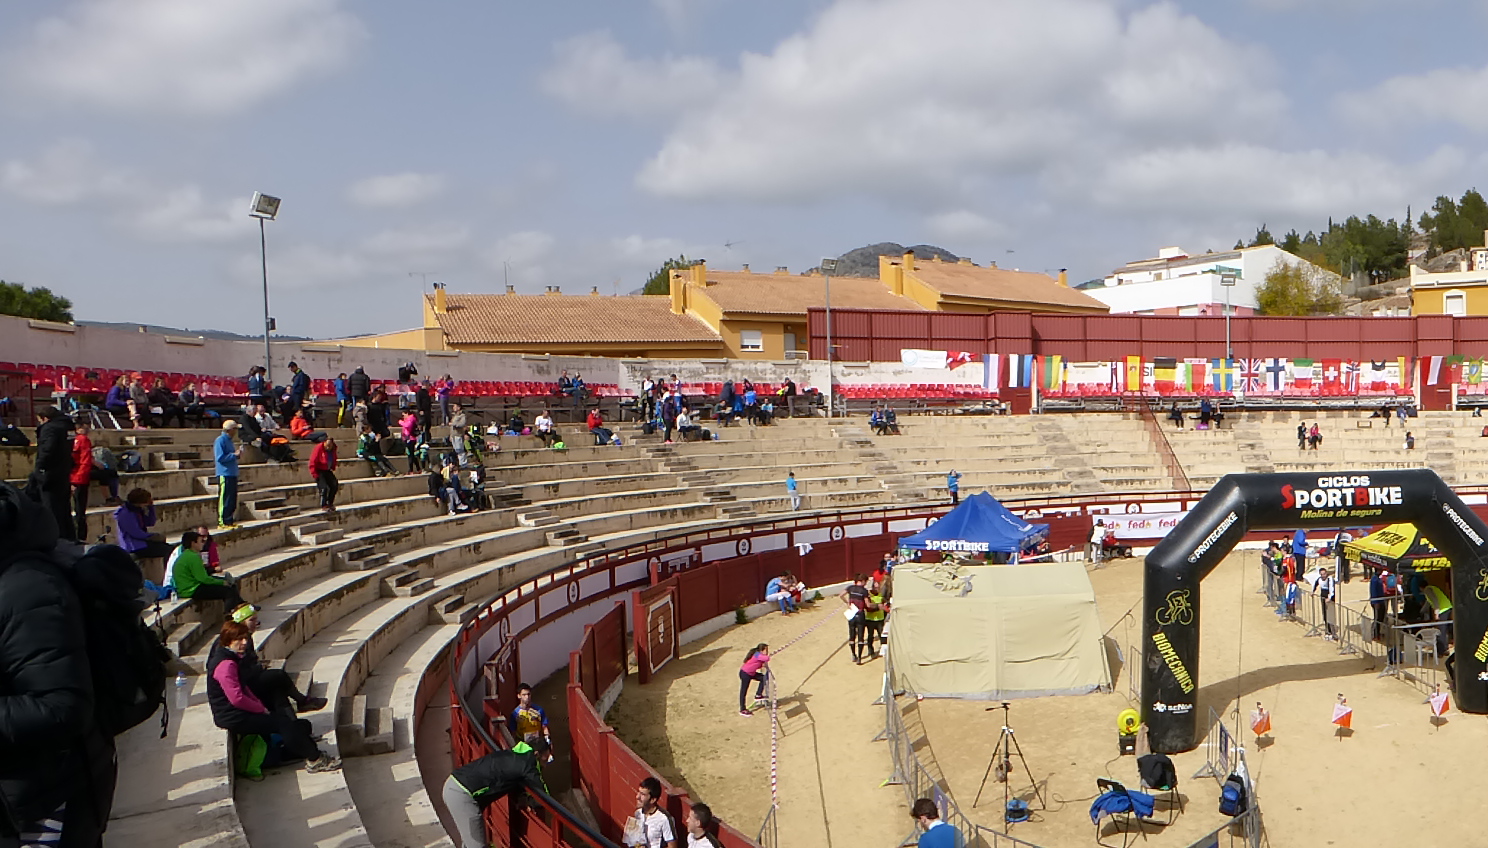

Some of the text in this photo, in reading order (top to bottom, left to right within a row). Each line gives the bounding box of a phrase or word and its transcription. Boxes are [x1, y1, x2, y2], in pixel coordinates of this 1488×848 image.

[1317, 475, 1371, 488] CICLOS
[1280, 484, 1403, 509] SPORTBIKE
[1300, 508, 1382, 519] Molina de segura
[1193, 511, 1239, 559] PROTEGEBIKE
[925, 540, 990, 552] SPORTBIKE
[1152, 632, 1195, 695] BIOMECANICA
